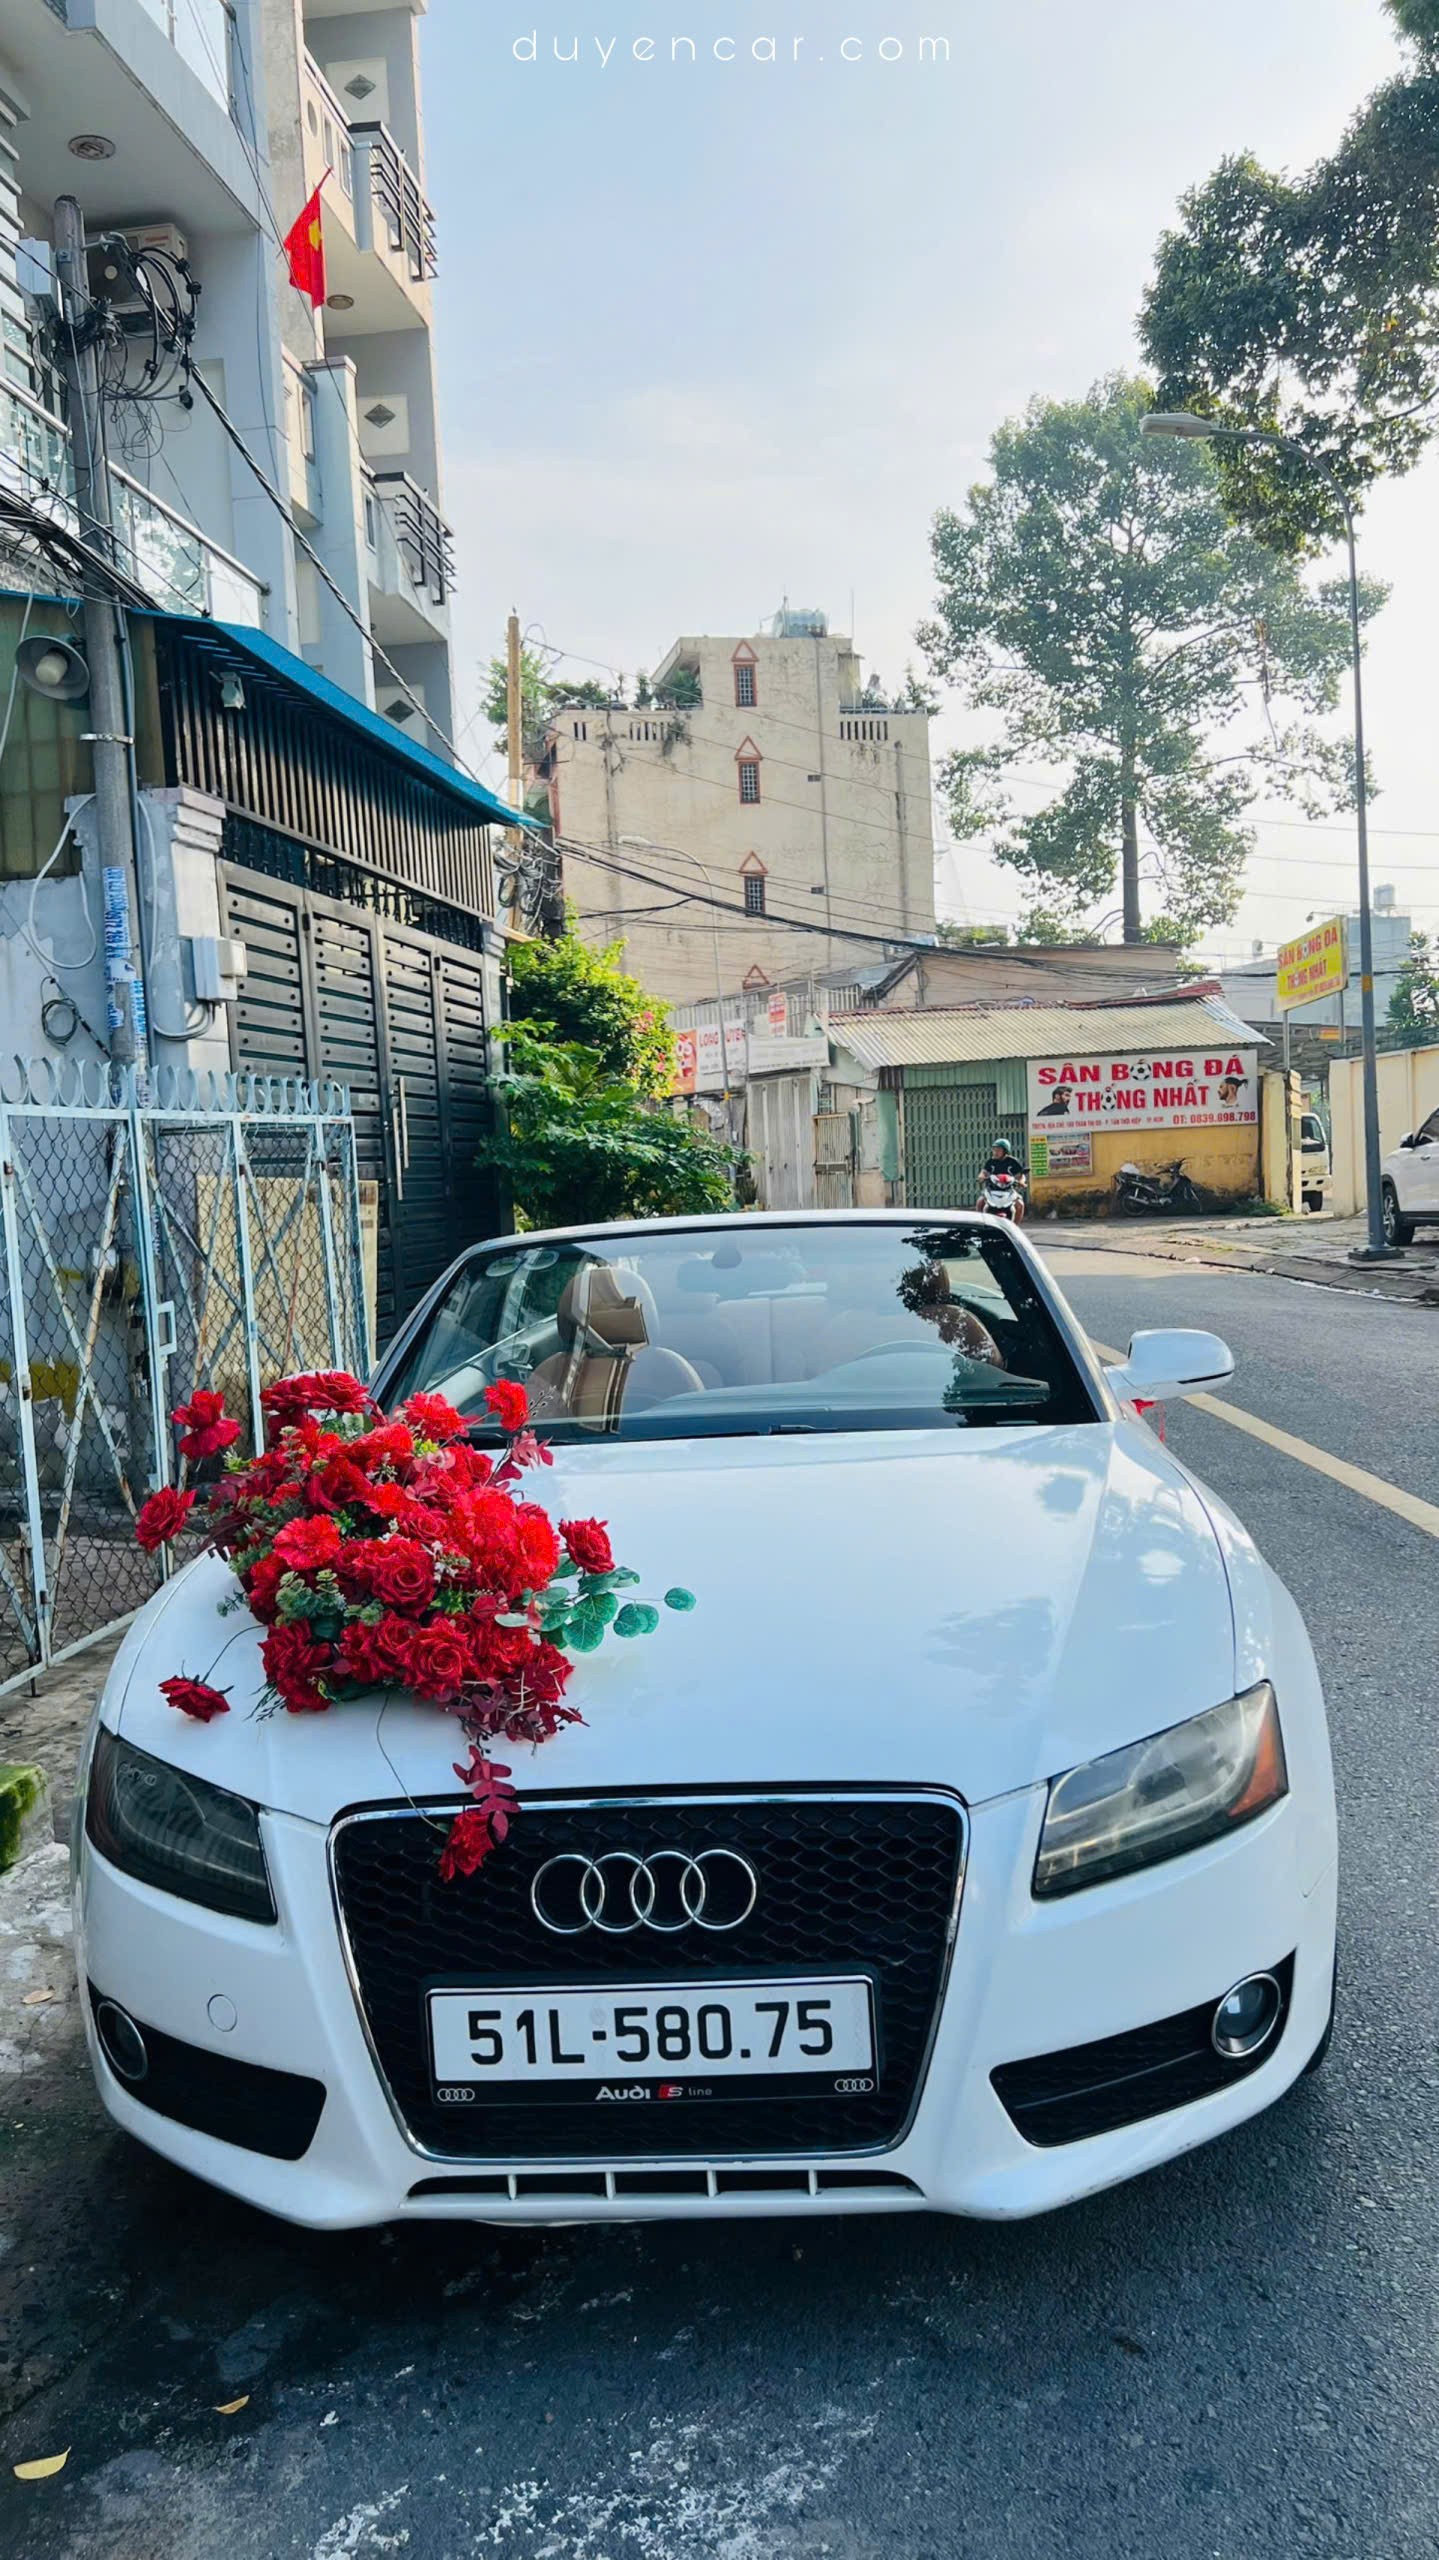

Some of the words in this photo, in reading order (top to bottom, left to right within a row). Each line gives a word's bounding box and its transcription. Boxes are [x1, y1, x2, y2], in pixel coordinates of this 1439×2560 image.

[1038, 1062, 1100, 1085] SÂN
[1204, 1054, 1244, 1076] ĐÁ
[1153, 1079, 1210, 1107] NHẤT
[468, 1999, 833, 2066] 51L-580.75
[595, 2085, 651, 2101] Audi
[688, 2087, 713, 2097] line
